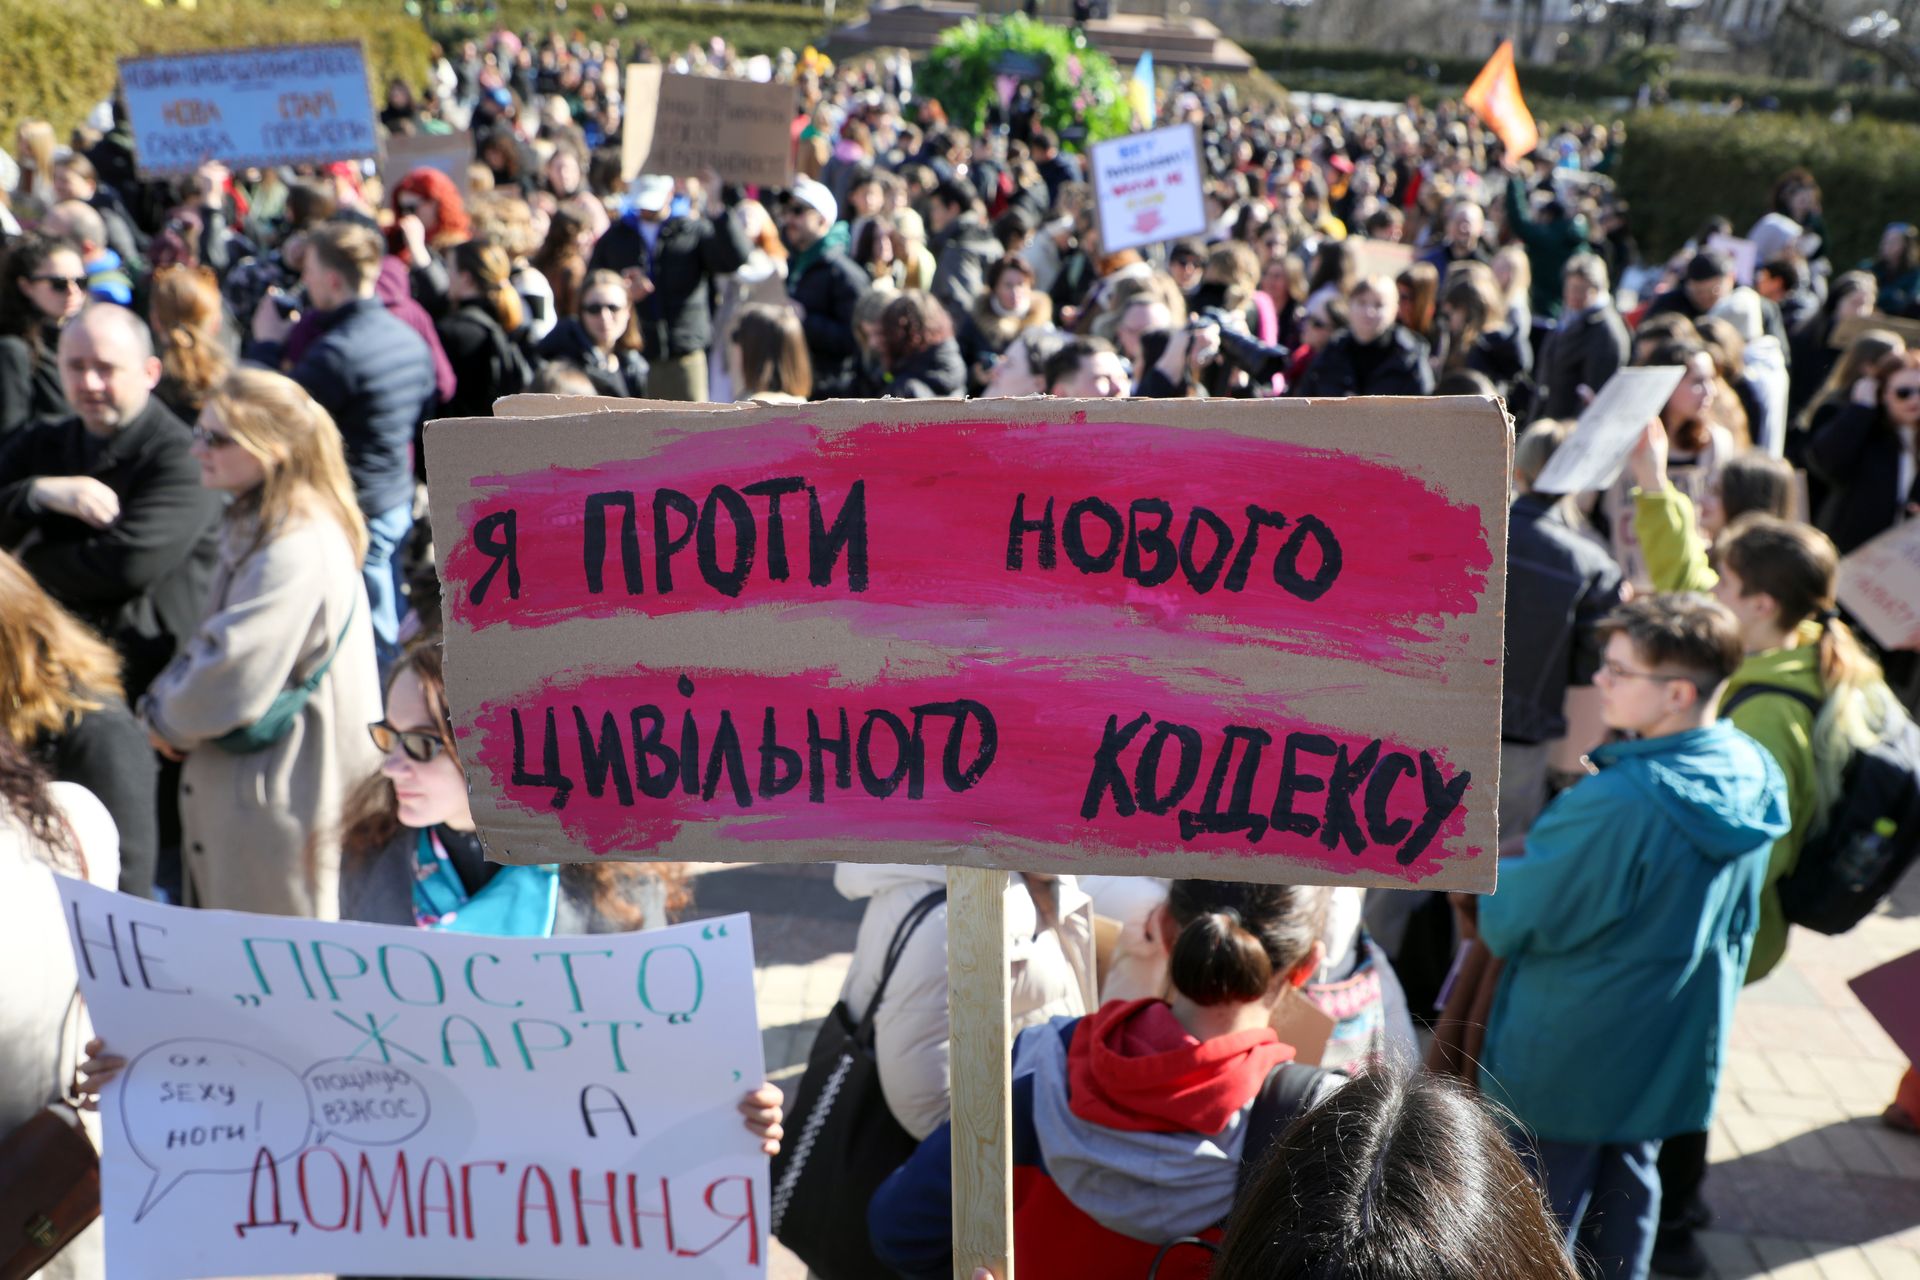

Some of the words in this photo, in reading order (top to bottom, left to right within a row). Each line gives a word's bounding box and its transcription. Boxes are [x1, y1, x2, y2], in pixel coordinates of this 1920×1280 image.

[469, 509, 521, 605] Я
[583, 476, 869, 597] ПРОТИ
[1006, 492, 1343, 602] НОВОГО
[511, 673, 998, 809] ЦИВІЛЬНОГО
[1080, 712, 1471, 865] КОДЕКСУ
[72, 901, 191, 995] НЕ
[580, 1083, 640, 1138] А
[235, 1145, 760, 1265] ДОМАГАННЯ
